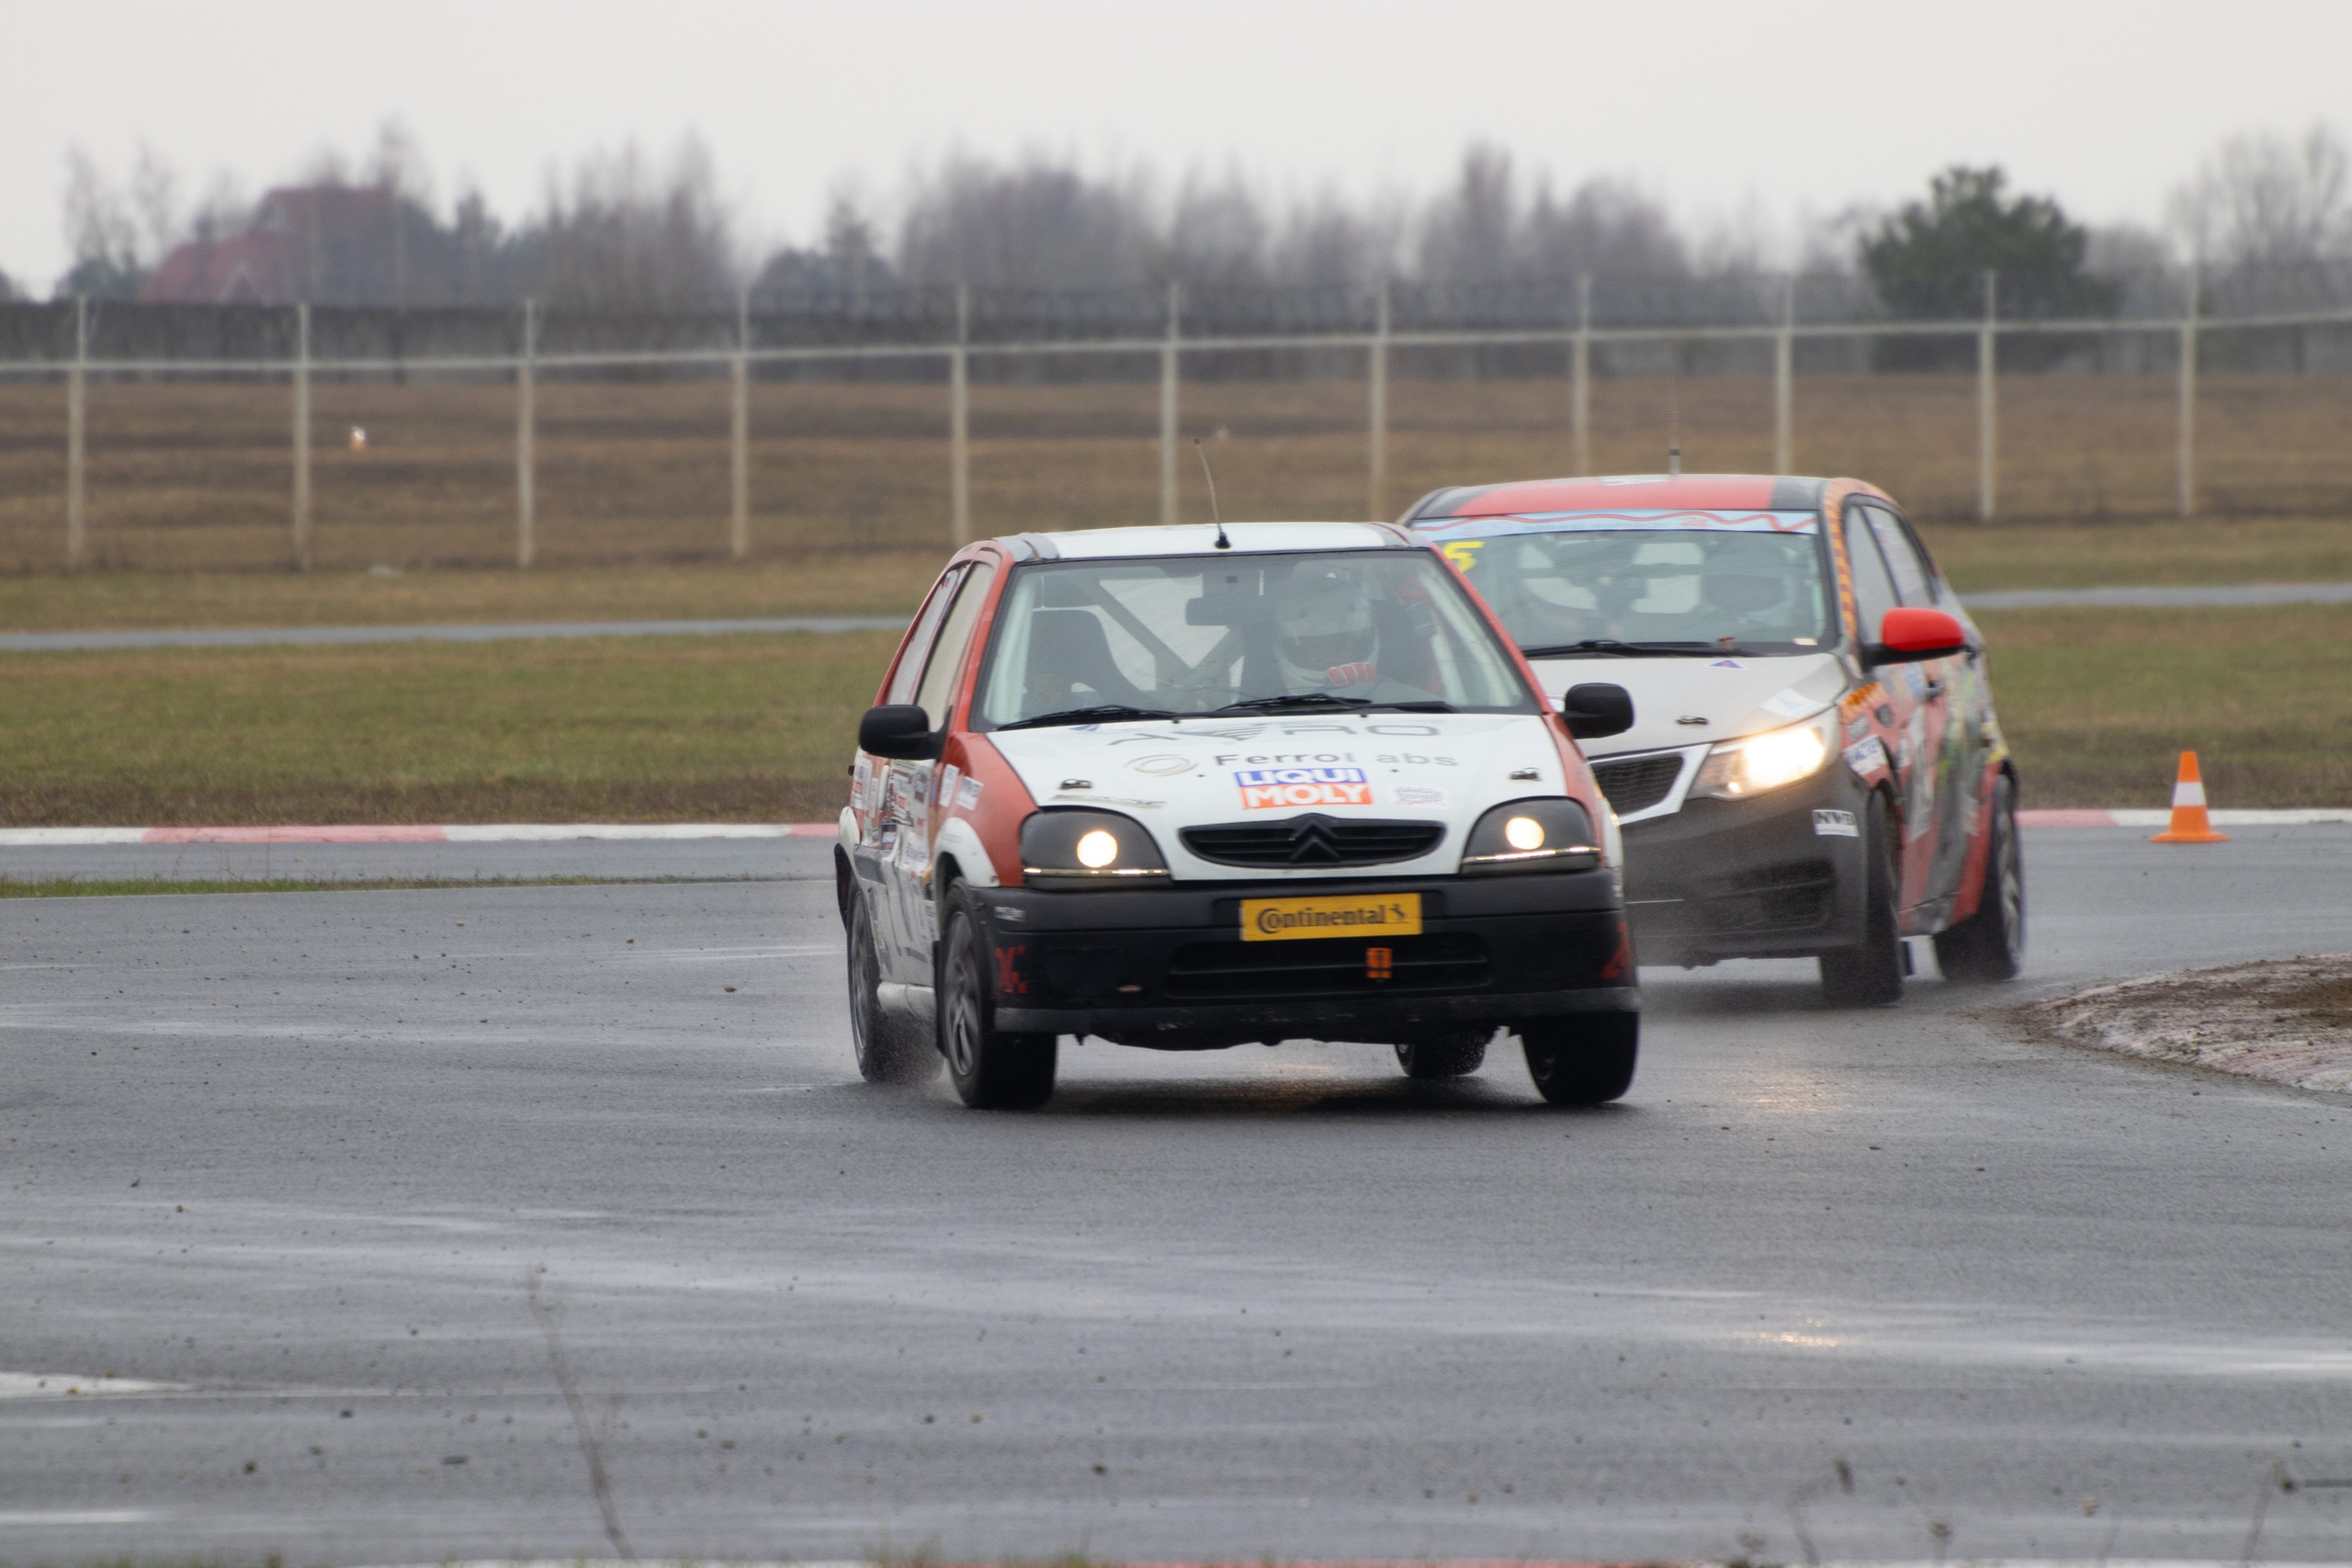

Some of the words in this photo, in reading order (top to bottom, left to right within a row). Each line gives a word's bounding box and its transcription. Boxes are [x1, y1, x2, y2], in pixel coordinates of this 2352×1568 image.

[1240, 768, 1363, 786] LIQUI
[1247, 784, 1368, 807] MOLY
[1258, 904, 1385, 934] Continental
